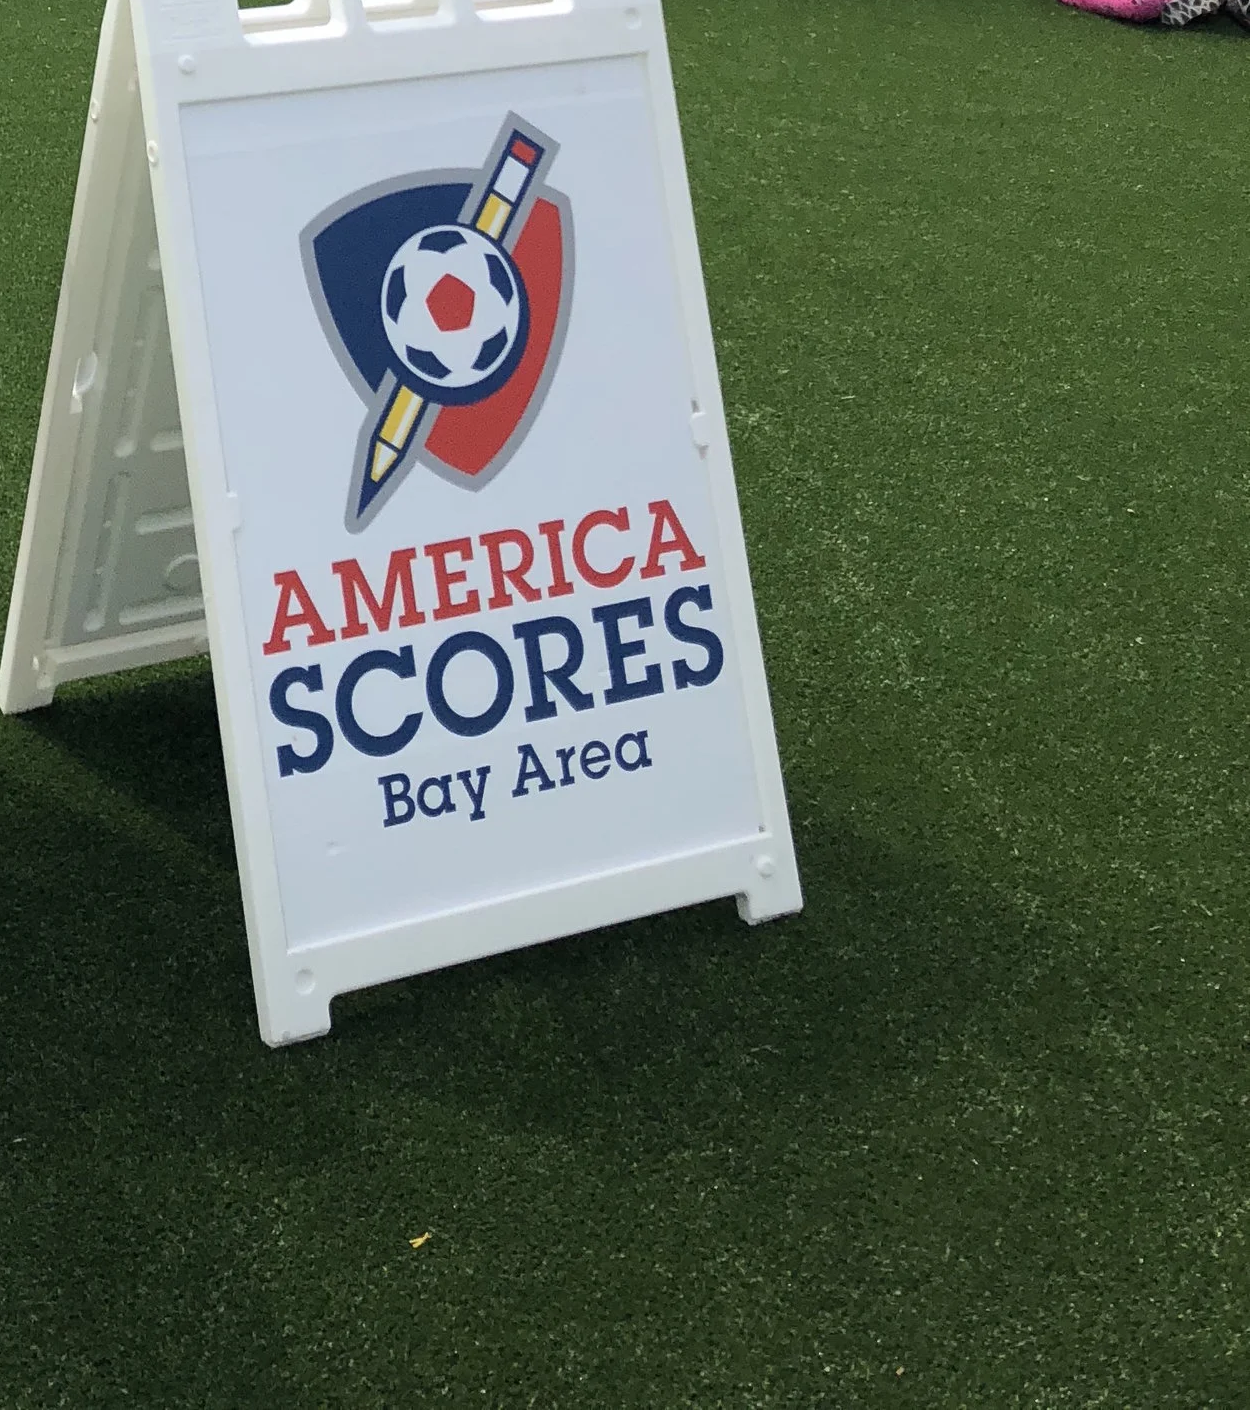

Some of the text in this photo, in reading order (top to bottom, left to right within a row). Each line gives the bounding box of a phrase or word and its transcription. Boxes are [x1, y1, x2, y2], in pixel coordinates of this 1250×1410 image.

[263, 500, 705, 656] AMERICA
[269, 583, 725, 778] SCORES
[378, 729, 654, 828] Bay Area
